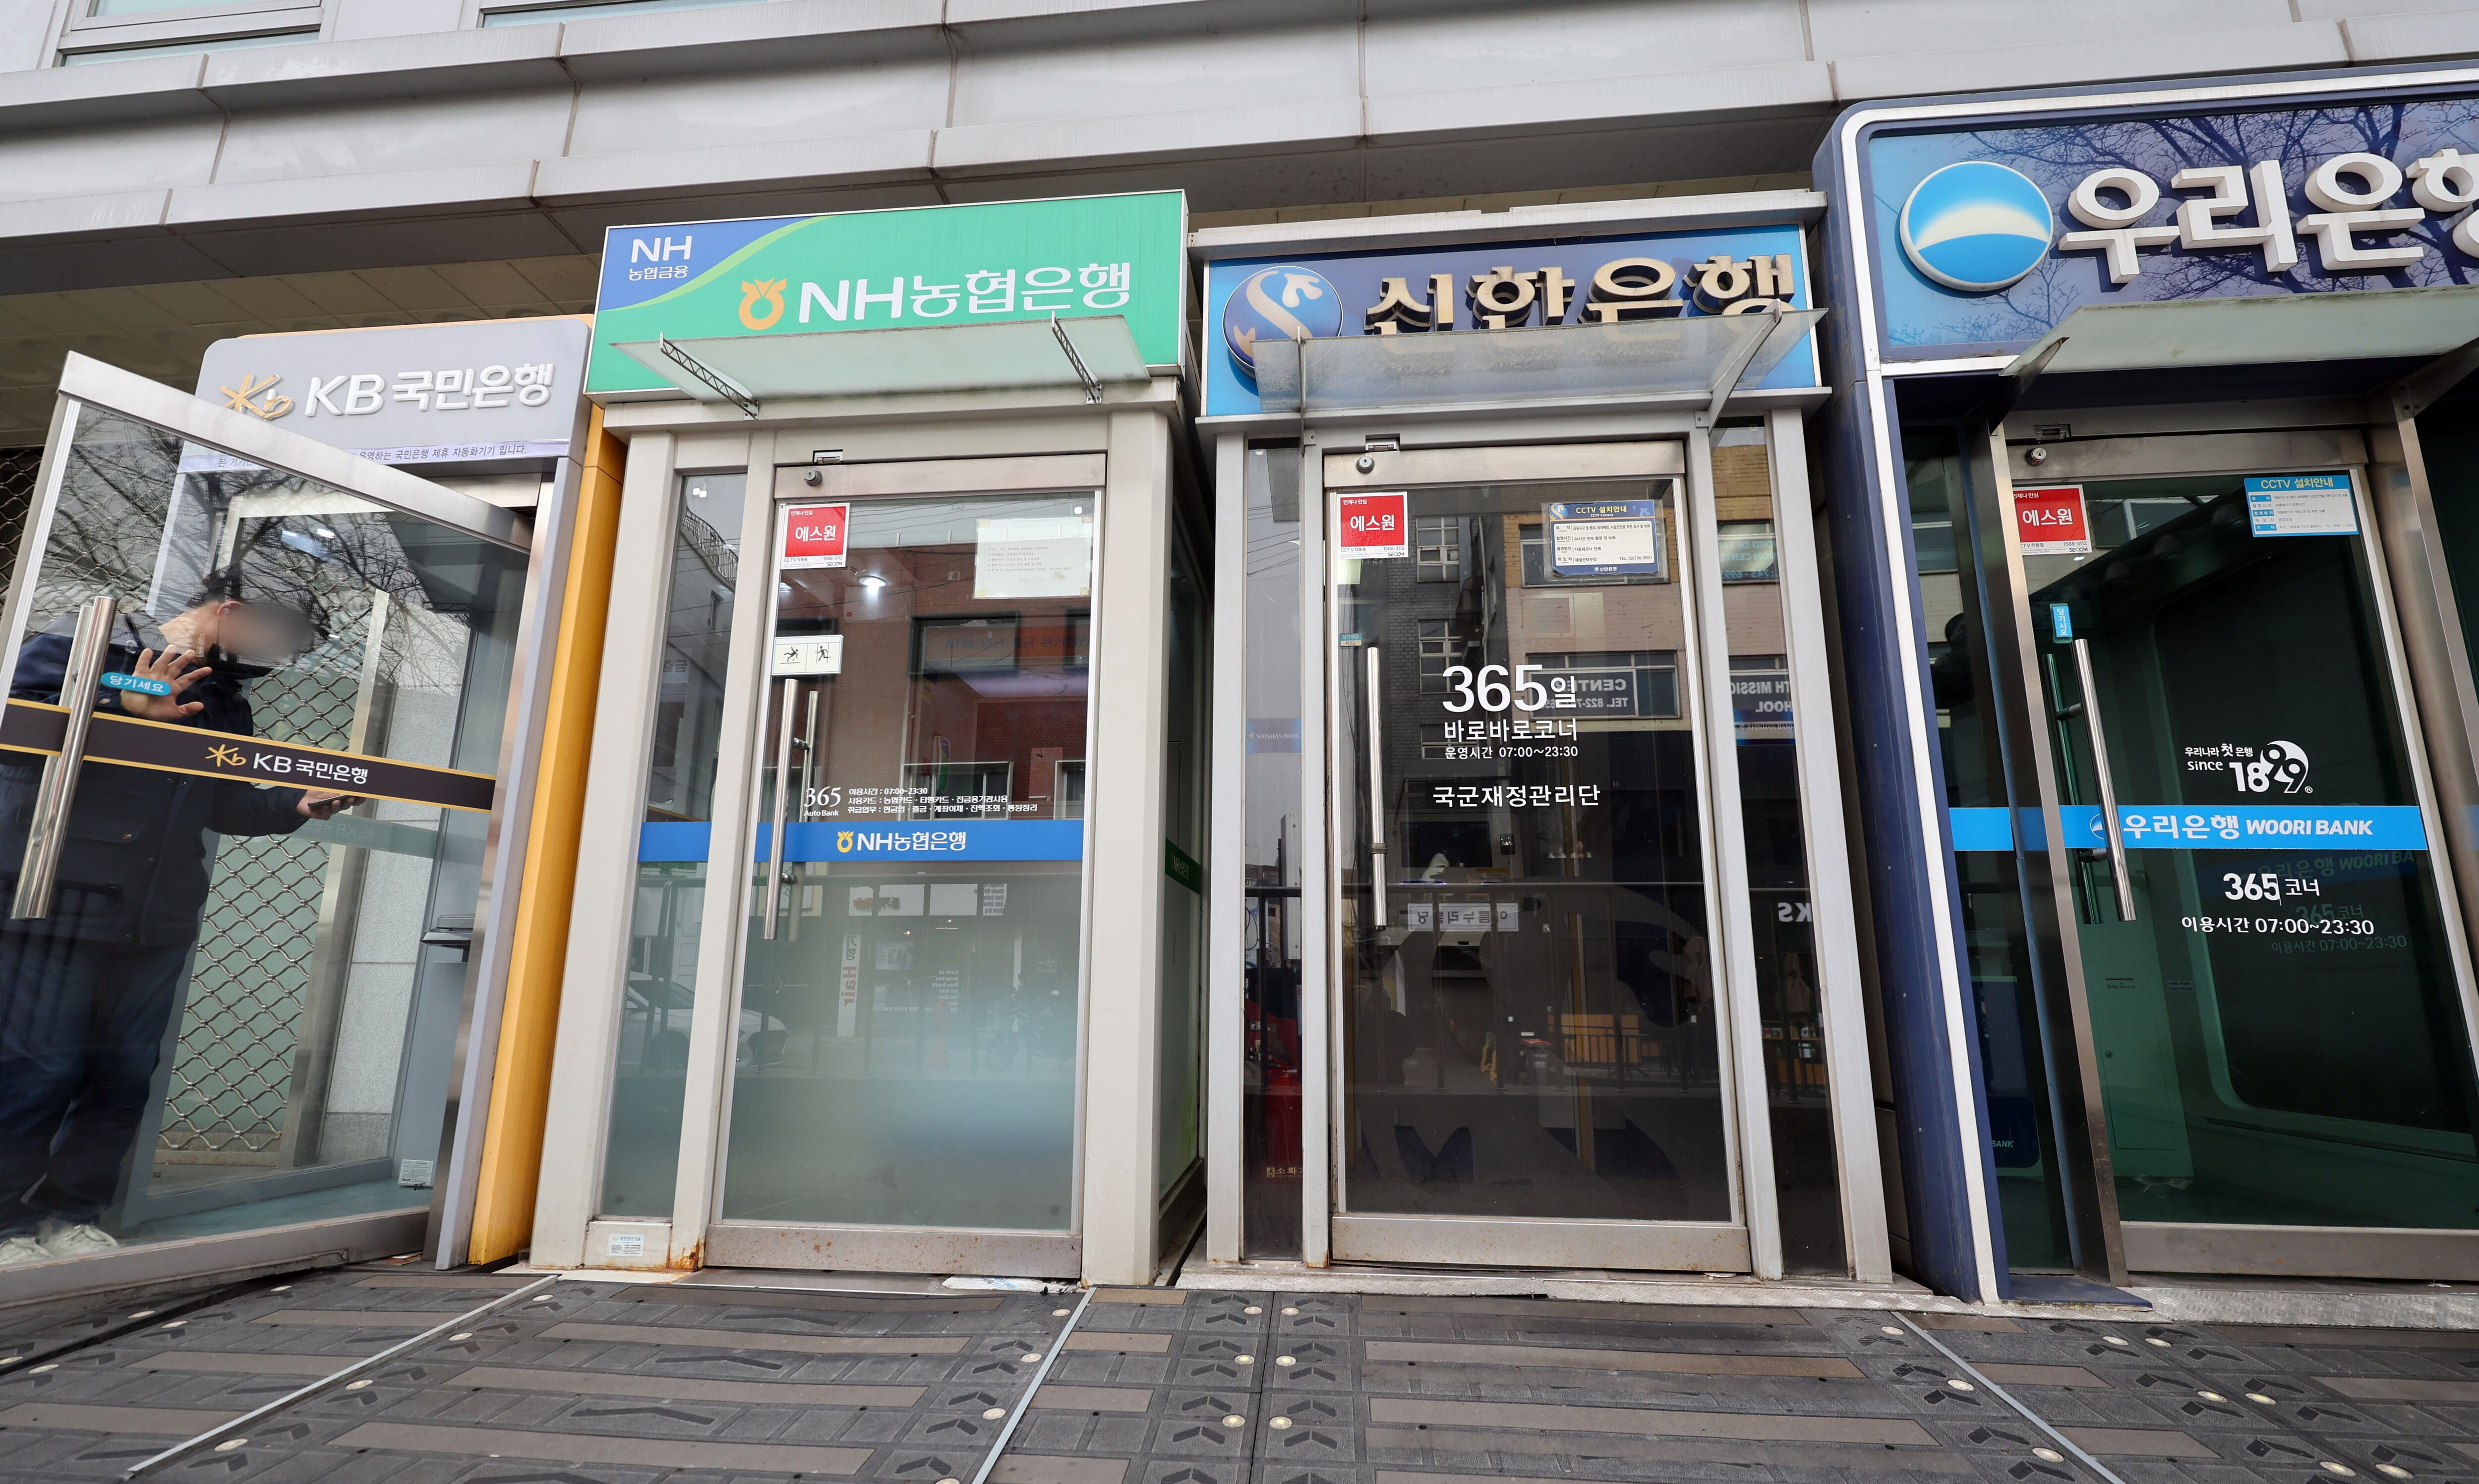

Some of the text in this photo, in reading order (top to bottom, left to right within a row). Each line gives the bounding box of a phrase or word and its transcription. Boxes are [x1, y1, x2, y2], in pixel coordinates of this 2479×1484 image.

[631, 236, 692, 263] NH
[628, 265, 689, 281] 농협금융
[798, 262, 1131, 323] NH농협은행
[1363, 253, 1794, 354] 신한은행
[305, 362, 556, 417] KB 국민은행
[395, 449, 429, 460] 국민은행
[432, 448, 449, 459] 제휴
[452, 446, 495, 458] 자동화기기
[499, 444, 527, 455] 입니다.
[218, 458, 227, 468] 본
[2261, 477, 2334, 489] CCTV 설치안내
[1350, 514, 1395, 532] 에스원
[2022, 508, 2073, 526] 에스원
[795, 525, 836, 542] 에스원
[2057, 608, 2068, 635] 당기시오
[110, 674, 164, 692] 당기세요
[1442, 664, 1577, 712] 365일
[1444, 718, 1577, 742] 바로바로코너
[1445, 746, 1493, 760] 운영시간
[2184, 743, 2253, 757] 우리나라 첫 은행
[253, 753, 368, 784] KB 국민은행
[2187, 761, 2224, 771] since
[804, 786, 841, 808] 365
[848, 796, 877, 805] 사용카드
[956, 795, 1008, 804] 전금융기관사용
[1433, 784, 1600, 807] 국군재정관리단
[848, 806, 877, 814] 취급업무
[934, 805, 963, 813] 계좌이체
[970, 804, 1001, 813] 잔액조회
[1007, 804, 1037, 812] 통장정리
[2123, 815, 2373, 839] 우리은행 WOORI BANK
[857, 831, 967, 852] NH농협은행
[2223, 873, 2321, 901] 365 코너
[2182, 916, 2375, 936] 이용시간 07:00~23:30
